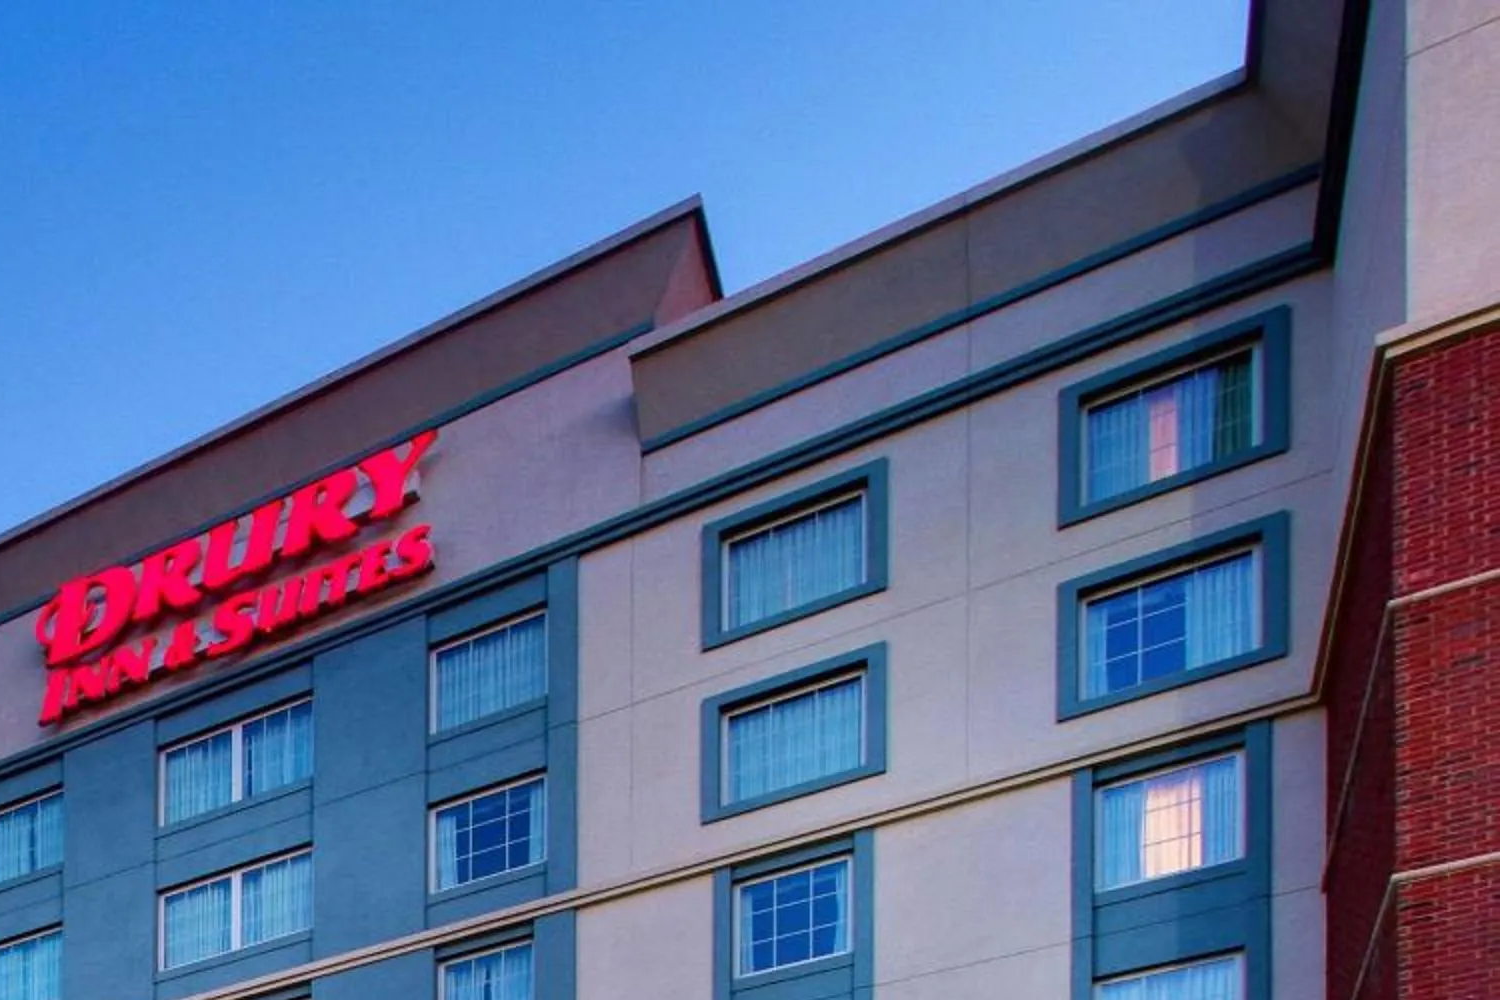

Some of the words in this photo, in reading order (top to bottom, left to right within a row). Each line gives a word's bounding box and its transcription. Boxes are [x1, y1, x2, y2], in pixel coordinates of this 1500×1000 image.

[36, 429, 438, 665] DRURY
[39, 637, 157, 725] INN
[163, 617, 196, 672] &
[207, 524, 435, 658] SUITES
